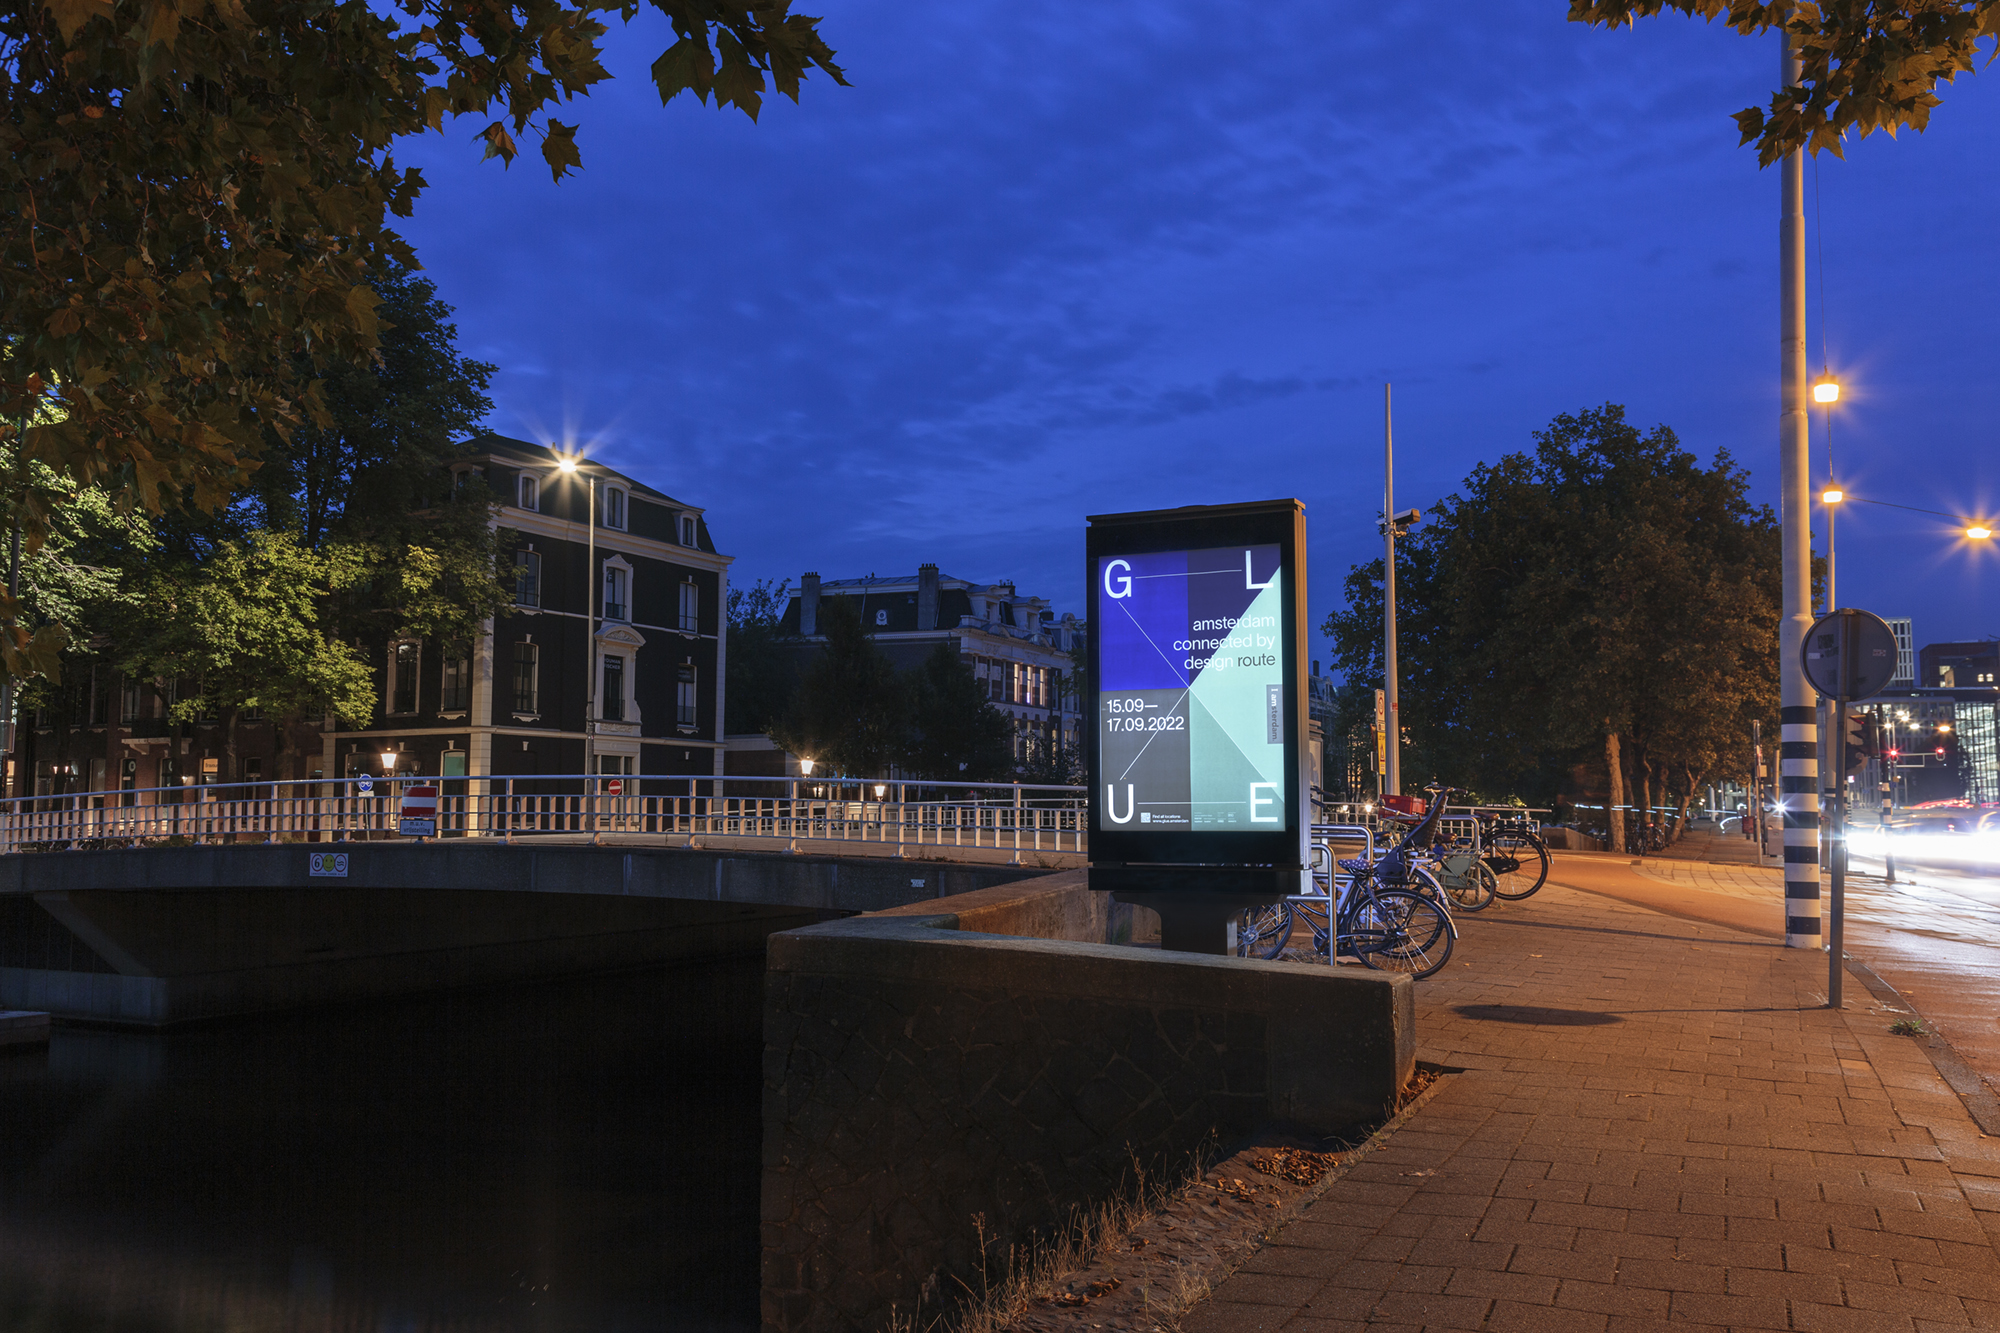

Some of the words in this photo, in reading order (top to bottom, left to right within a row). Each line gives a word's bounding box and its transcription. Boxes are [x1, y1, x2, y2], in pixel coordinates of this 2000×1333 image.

[1104, 559, 1132, 599] G
[1245, 550, 1274, 590] L
[1192, 614, 1275, 631] amsterdam
[1173, 633, 1252, 651] connected
[1256, 633, 1276, 650] by
[1184, 654, 1234, 672] design
[1237, 653, 1276, 667] route
[1106, 716, 1185, 732] 17.09.2022
[1107, 783, 1135, 824] U
[1249, 782, 1279, 823] E
[314, 857, 320, 868] 6
